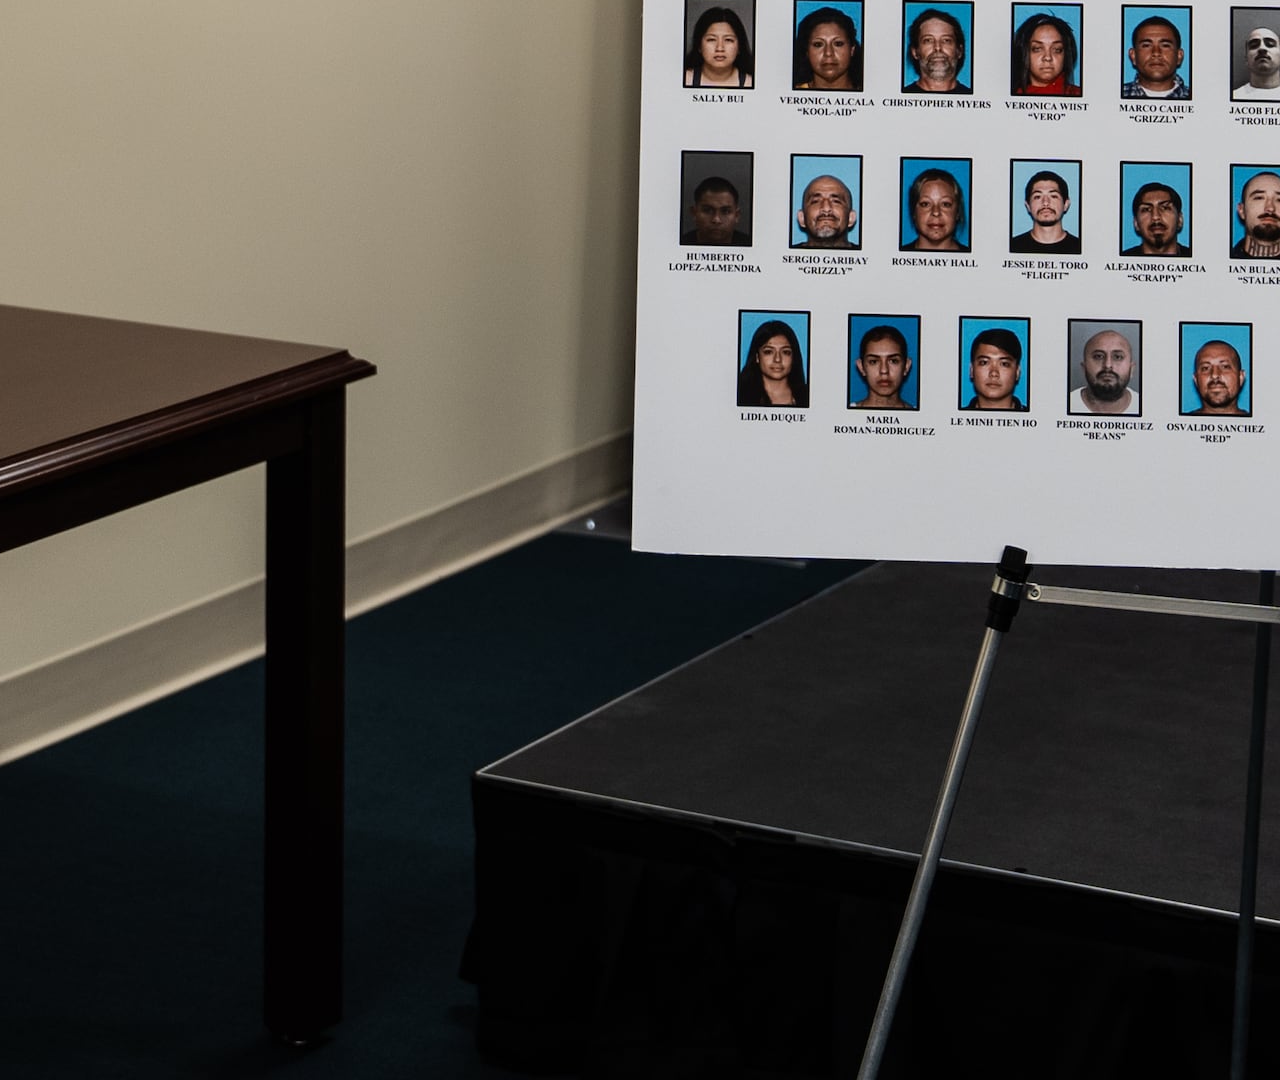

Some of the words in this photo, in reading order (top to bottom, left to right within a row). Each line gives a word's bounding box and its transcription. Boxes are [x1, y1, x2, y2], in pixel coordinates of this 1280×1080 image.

[692, 93, 725, 103] SALLY
[727, 94, 744, 103] BUI
[779, 95, 832, 105] VERONICA
[833, 97, 875, 106] ALCALA
[881, 98, 954, 108] CHRISTOPHER
[956, 99, 992, 109] MYERS
[1004, 100, 1058, 111] VERONICA
[1119, 103, 1157, 113] MARCO
[1158, 104, 1194, 114] CAHUE
[1228, 105, 1263, 115] JACOB
[686, 251, 744, 262] HUMBERTO
[781, 254, 821, 264] SERGIO
[822, 255, 869, 265] GARIBAY
[668, 262, 762, 273] LOPEZ-ALMENDRA
[891, 257, 949, 267] ROSEMARY
[950, 258, 979, 268] HALL
[1001, 259, 1035, 269] JESSIE
[1036, 260, 1058, 269] DEL
[1058, 260, 1089, 270] TORO
[1103, 262, 1165, 272] ALEJANDRO
[1166, 263, 1206, 273] GARCIA
[1228, 264, 1247, 273] IAN
[740, 411, 769, 421] LIDIA
[770, 412, 806, 423] DUQUE
[865, 415, 900, 425] MARIA
[950, 417, 964, 426] LE
[965, 417, 994, 427] MINH
[994, 418, 1020, 427] TIEN
[1021, 418, 1038, 428] HO
[833, 425, 936, 436] ROMAN-RODRIGUEZ
[1056, 419, 1091, 429] PEDRO
[1092, 420, 1154, 431] RODRIGUEZ
[1165, 422, 1216, 432] OSVALDO
[1216, 423, 1265, 434] SANCHEZ
